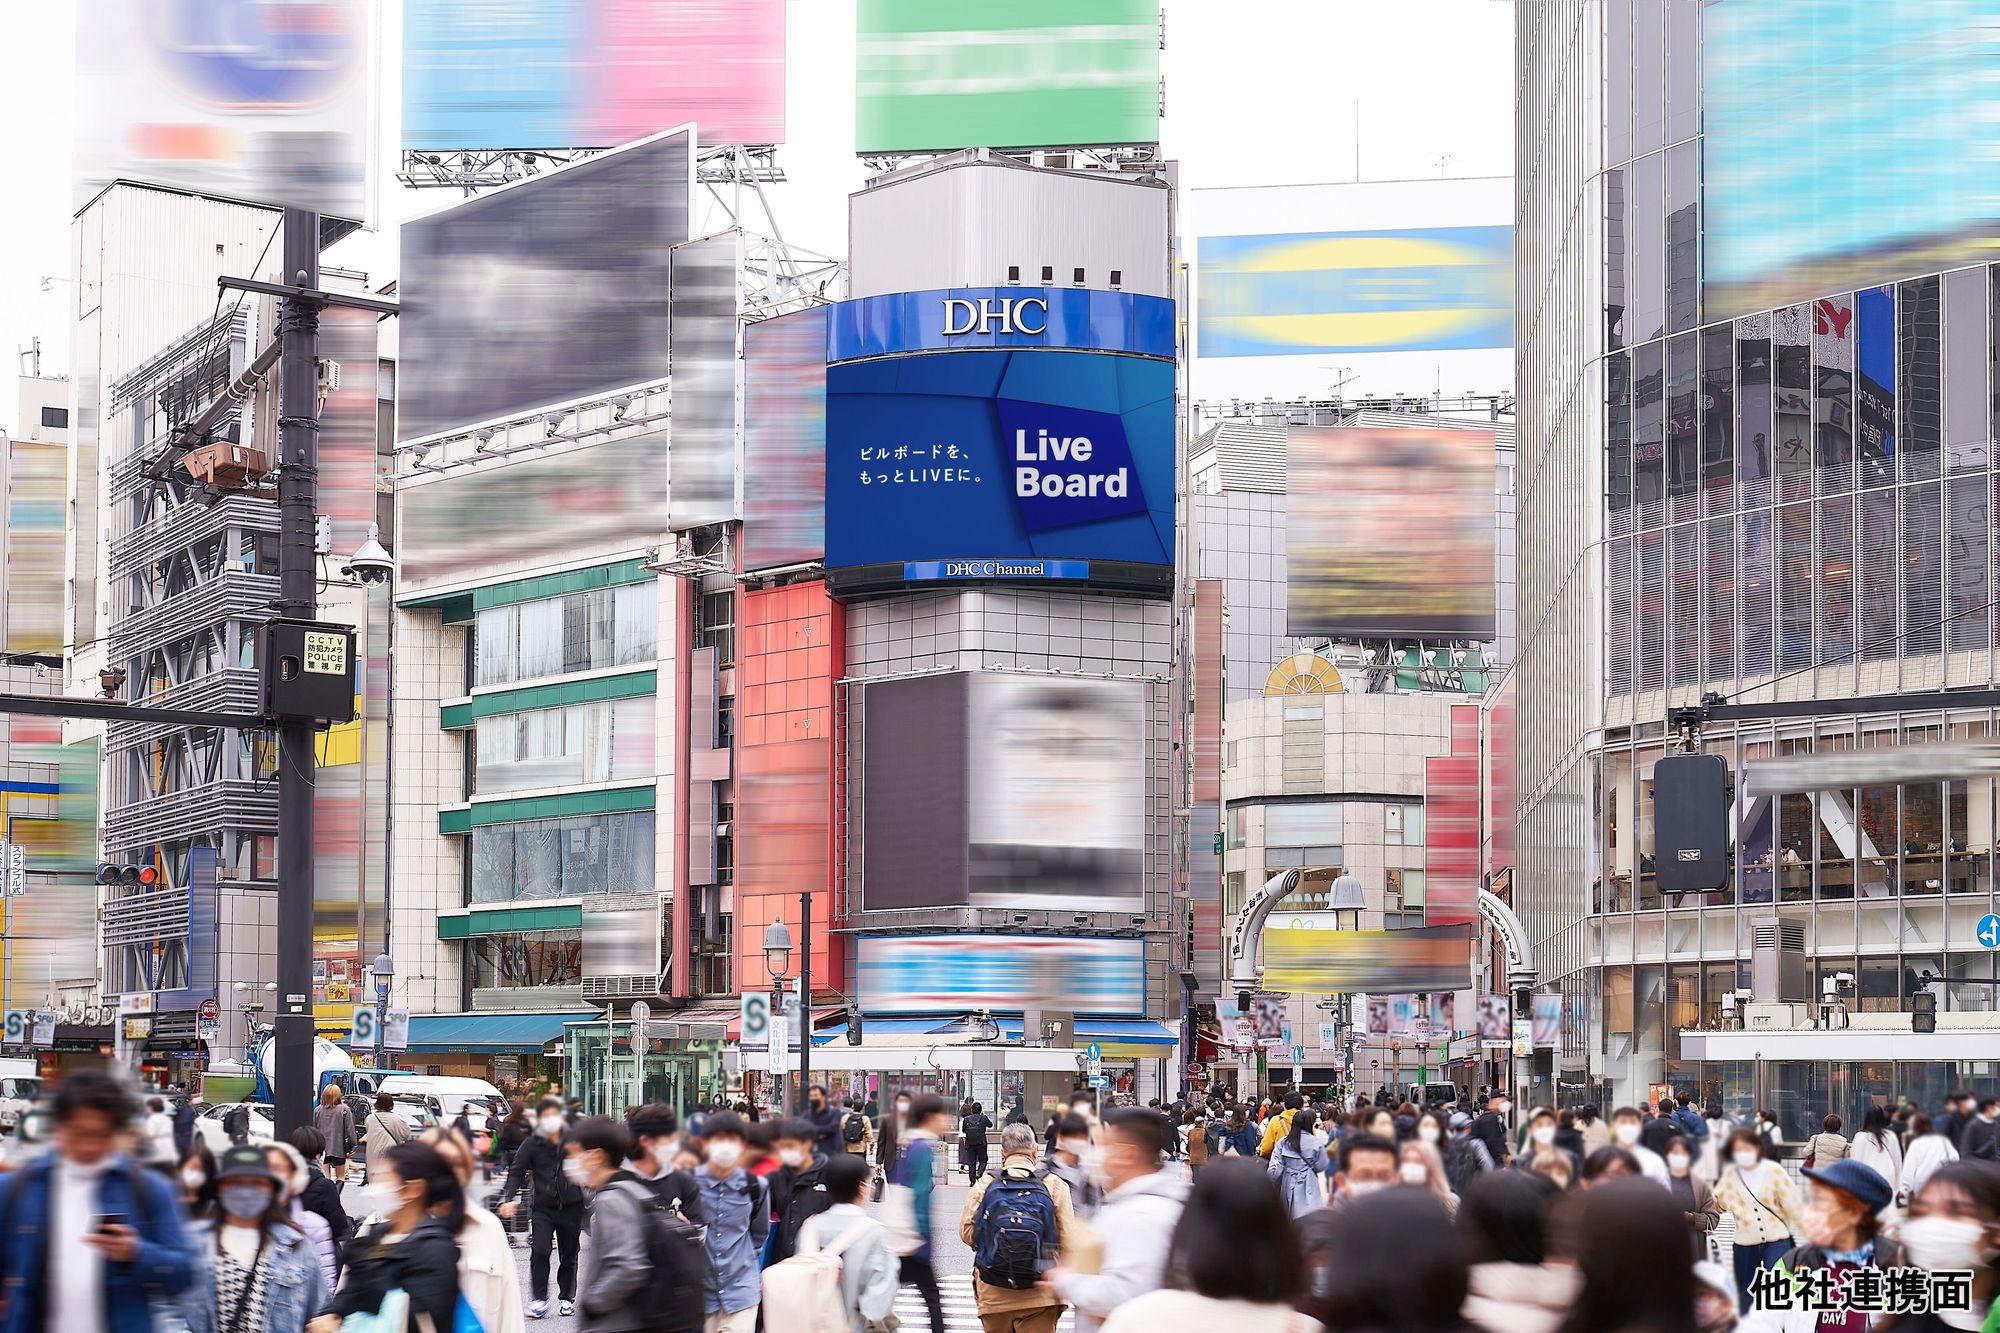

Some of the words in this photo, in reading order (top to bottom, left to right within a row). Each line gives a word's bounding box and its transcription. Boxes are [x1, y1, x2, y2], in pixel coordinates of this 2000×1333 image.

[941, 298, 1048, 336] DHC
[859, 443, 970, 462] ビルボードを、
[1016, 429, 1093, 462] Live
[859, 468, 982, 485] もっとLIVEに。
[1016, 467, 1128, 498] Board
[945, 562, 981, 577] DHC
[983, 562, 1045, 577] Channel
[307, 644, 343, 654] 防犯カメラ
[308, 636, 343, 645] CCTV
[307, 653, 343, 663] POLICE
[307, 661, 343, 671] 警視庁
[12, 846, 22, 894] スクランブル式
[6, 1012, 22, 1036] S
[355, 1010, 373, 1039] S
[746, 997, 767, 1033] S
